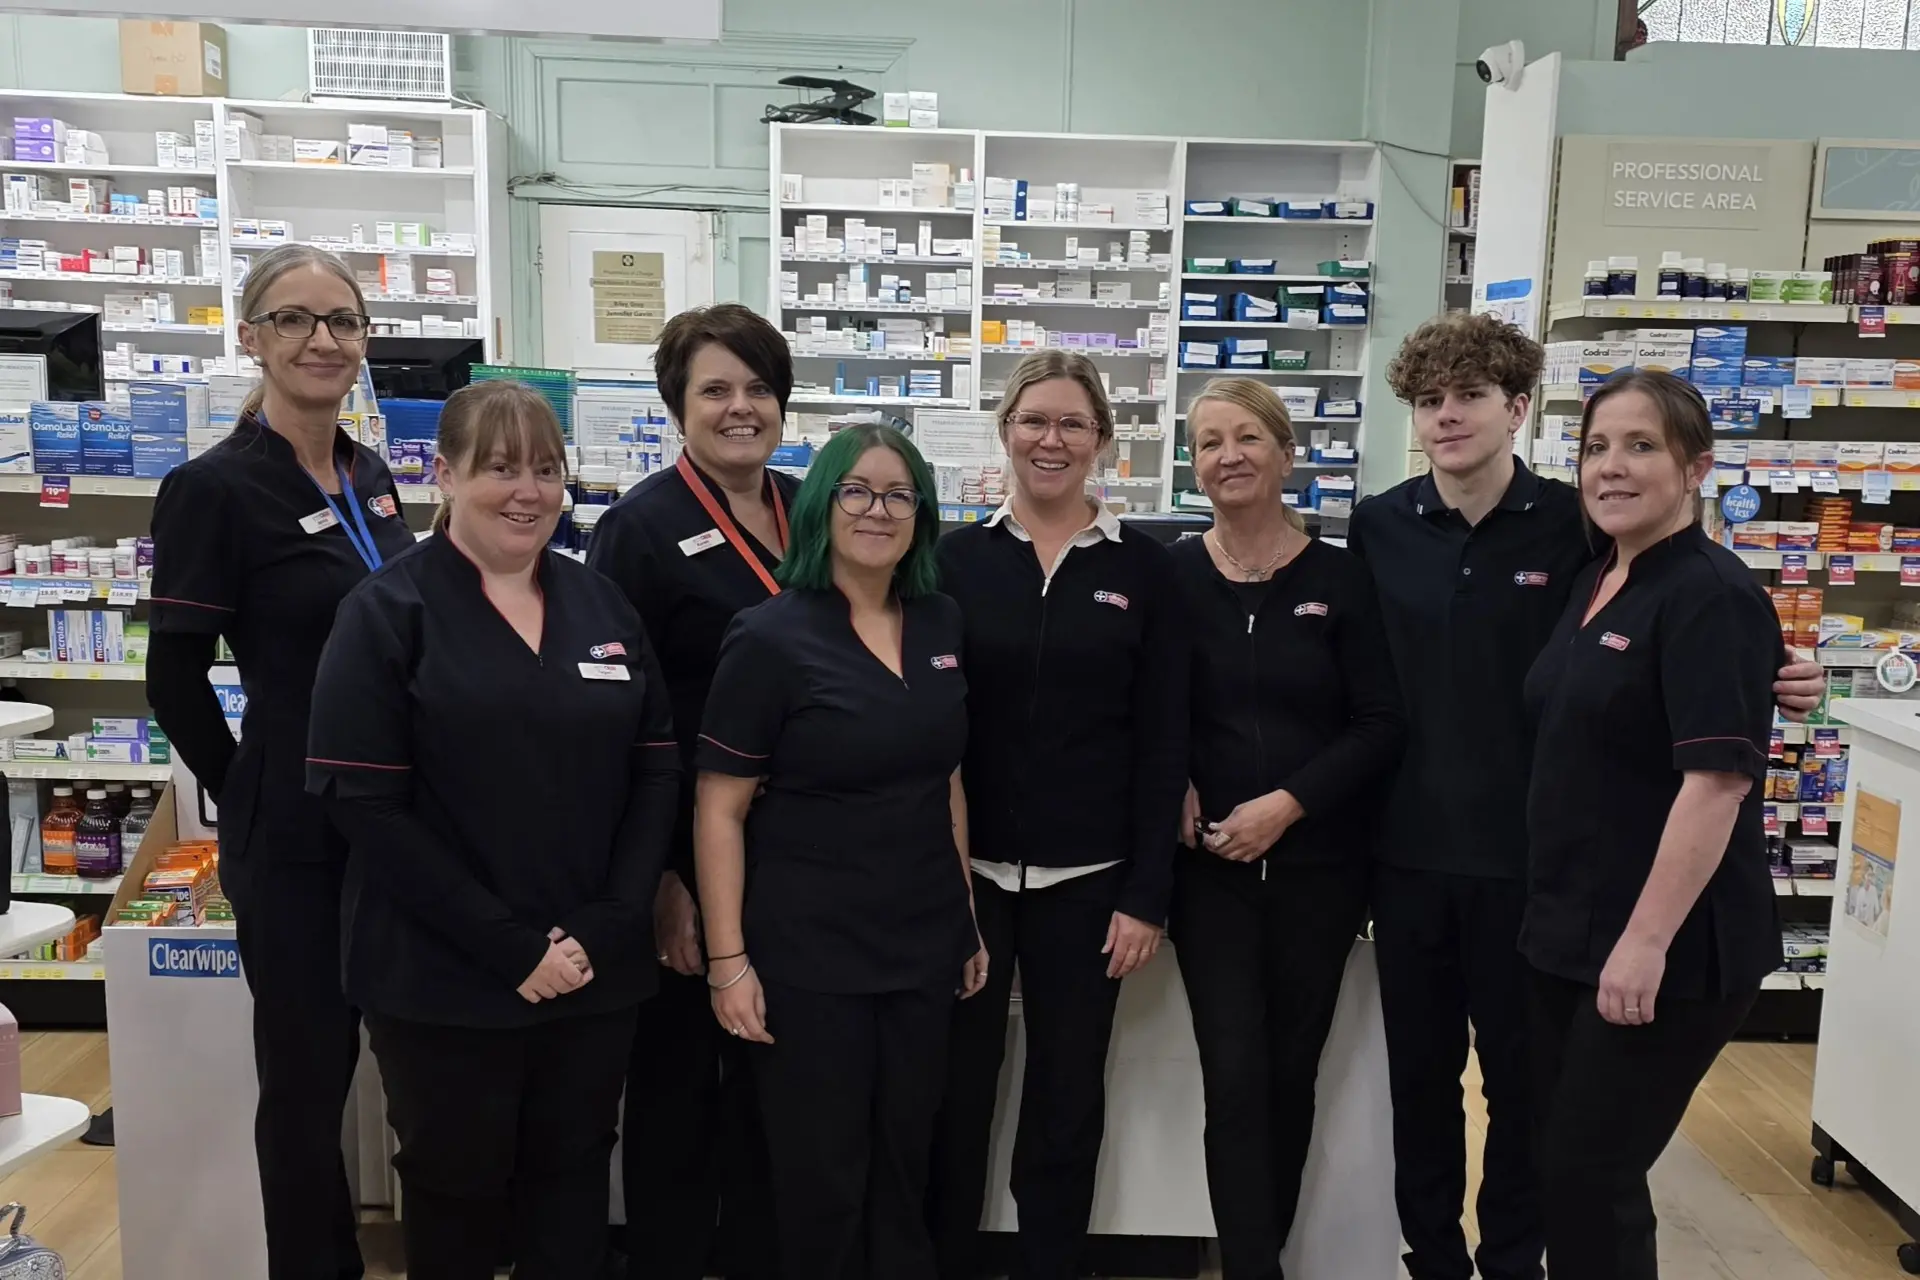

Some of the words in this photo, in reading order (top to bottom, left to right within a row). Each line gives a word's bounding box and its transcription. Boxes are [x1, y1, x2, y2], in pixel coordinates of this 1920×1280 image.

[1612, 162, 1763, 183] PROFESSIONAL
[1613, 190, 1695, 209] SERVICE
[1702, 193, 1758, 211] AREA
[1583, 348, 1610, 357] Codral
[1639, 348, 1666, 357] Codral
[32, 422, 79, 432] OsmoLax
[82, 422, 131, 432] OsmoLax
[107, 432, 130, 440] Relief
[1725, 495, 1756, 510] health
[57, 620, 68, 659] microlax
[93, 621, 104, 659] microlax
[151, 942, 237, 974] Clearwipe
